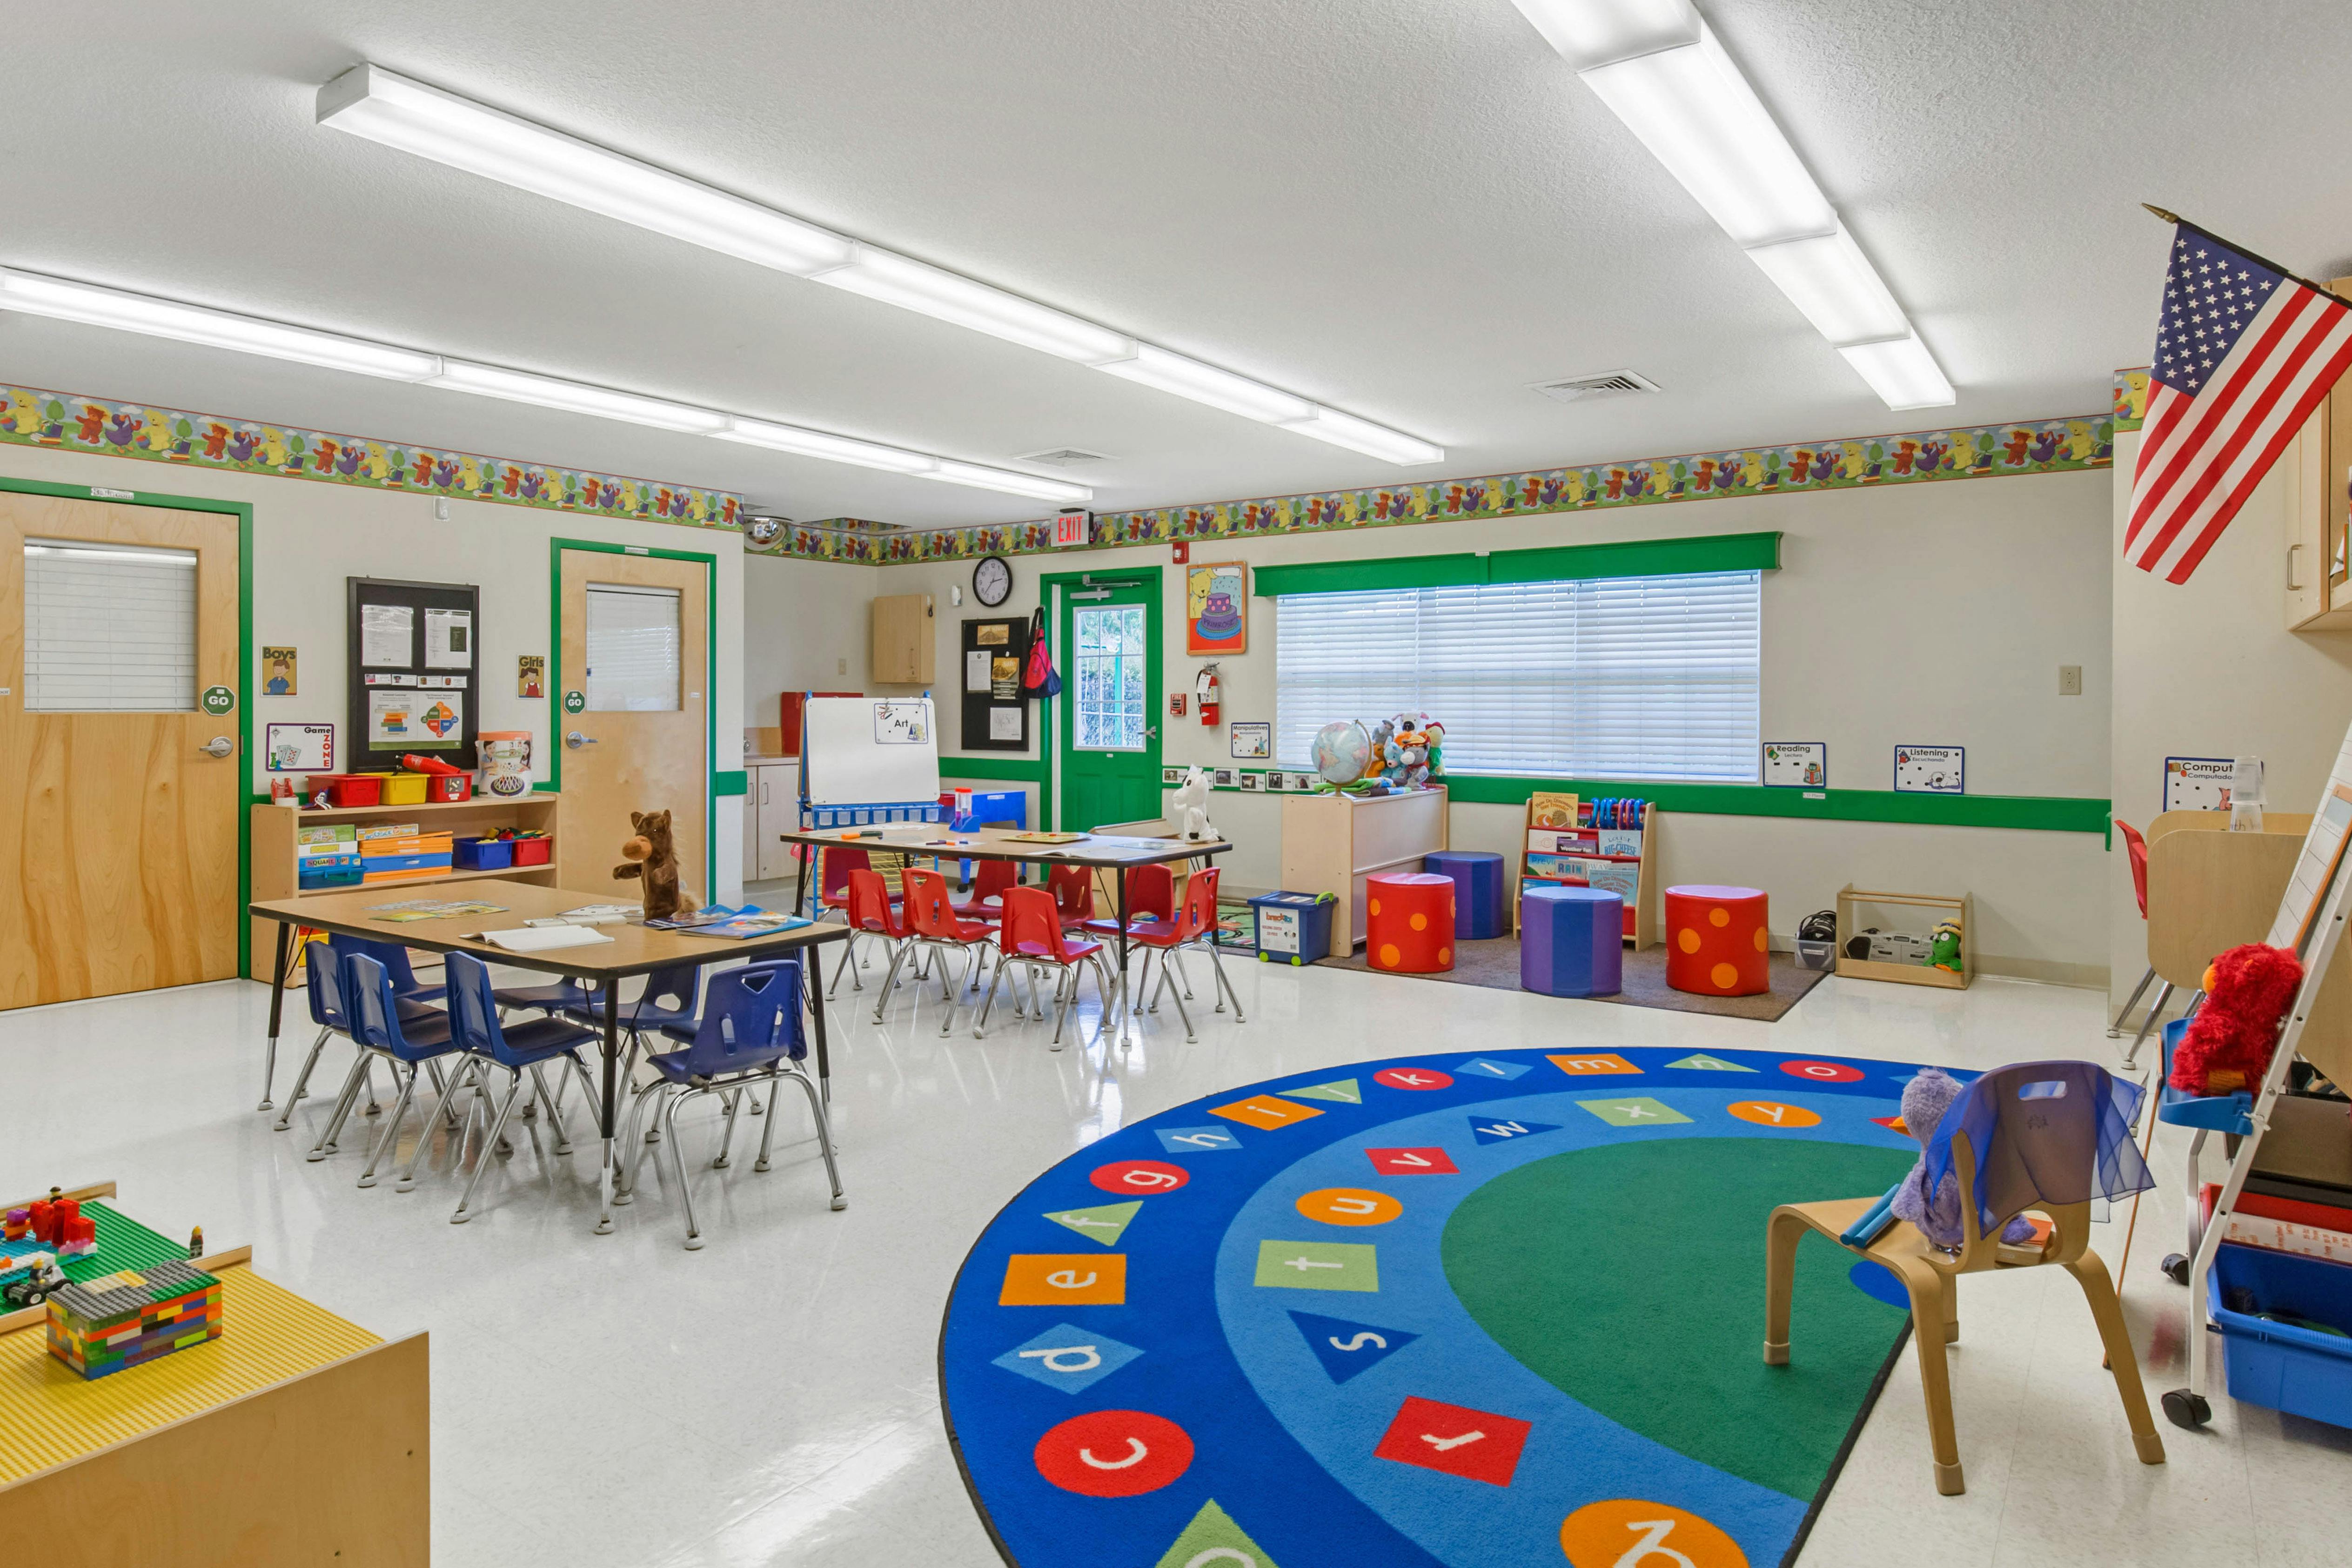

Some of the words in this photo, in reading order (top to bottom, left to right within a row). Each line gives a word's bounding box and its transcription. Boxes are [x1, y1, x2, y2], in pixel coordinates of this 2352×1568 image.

[1059, 515, 1083, 542] EXIT
[263, 648, 296, 661] Boys
[519, 657, 543, 667] Girls
[208, 696, 229, 705] GO
[322, 734, 331, 767] ZONE
[1910, 749, 1949, 757] Listening
[2183, 762, 2233, 773] Comput
[1532, 857, 1556, 865] Previ
[1558, 863, 1582, 874] RAIN
[1567, 1059, 1617, 1070] m
[1690, 1060, 1725, 1071] n
[1804, 1066, 1837, 1076] o
[1389, 1072, 1435, 1086] k
[1317, 1086, 1357, 1101] j
[1246, 1105, 1287, 1118] i
[1614, 1105, 1659, 1118] x
[1752, 1106, 1784, 1123] y
[1476, 1120, 1529, 1137] w
[1172, 1133, 1230, 1148] h
[1391, 1153, 1433, 1167] v
[1123, 1169, 1178, 1188] g
[1330, 1197, 1378, 1214] u
[1061, 1214, 1120, 1227] f
[1284, 1256, 1344, 1271] t
[1046, 1270, 1097, 1289] e
[1329, 1332, 1387, 1352] s
[1019, 1345, 1102, 1373] d
[1079, 1437, 1148, 1470] c
